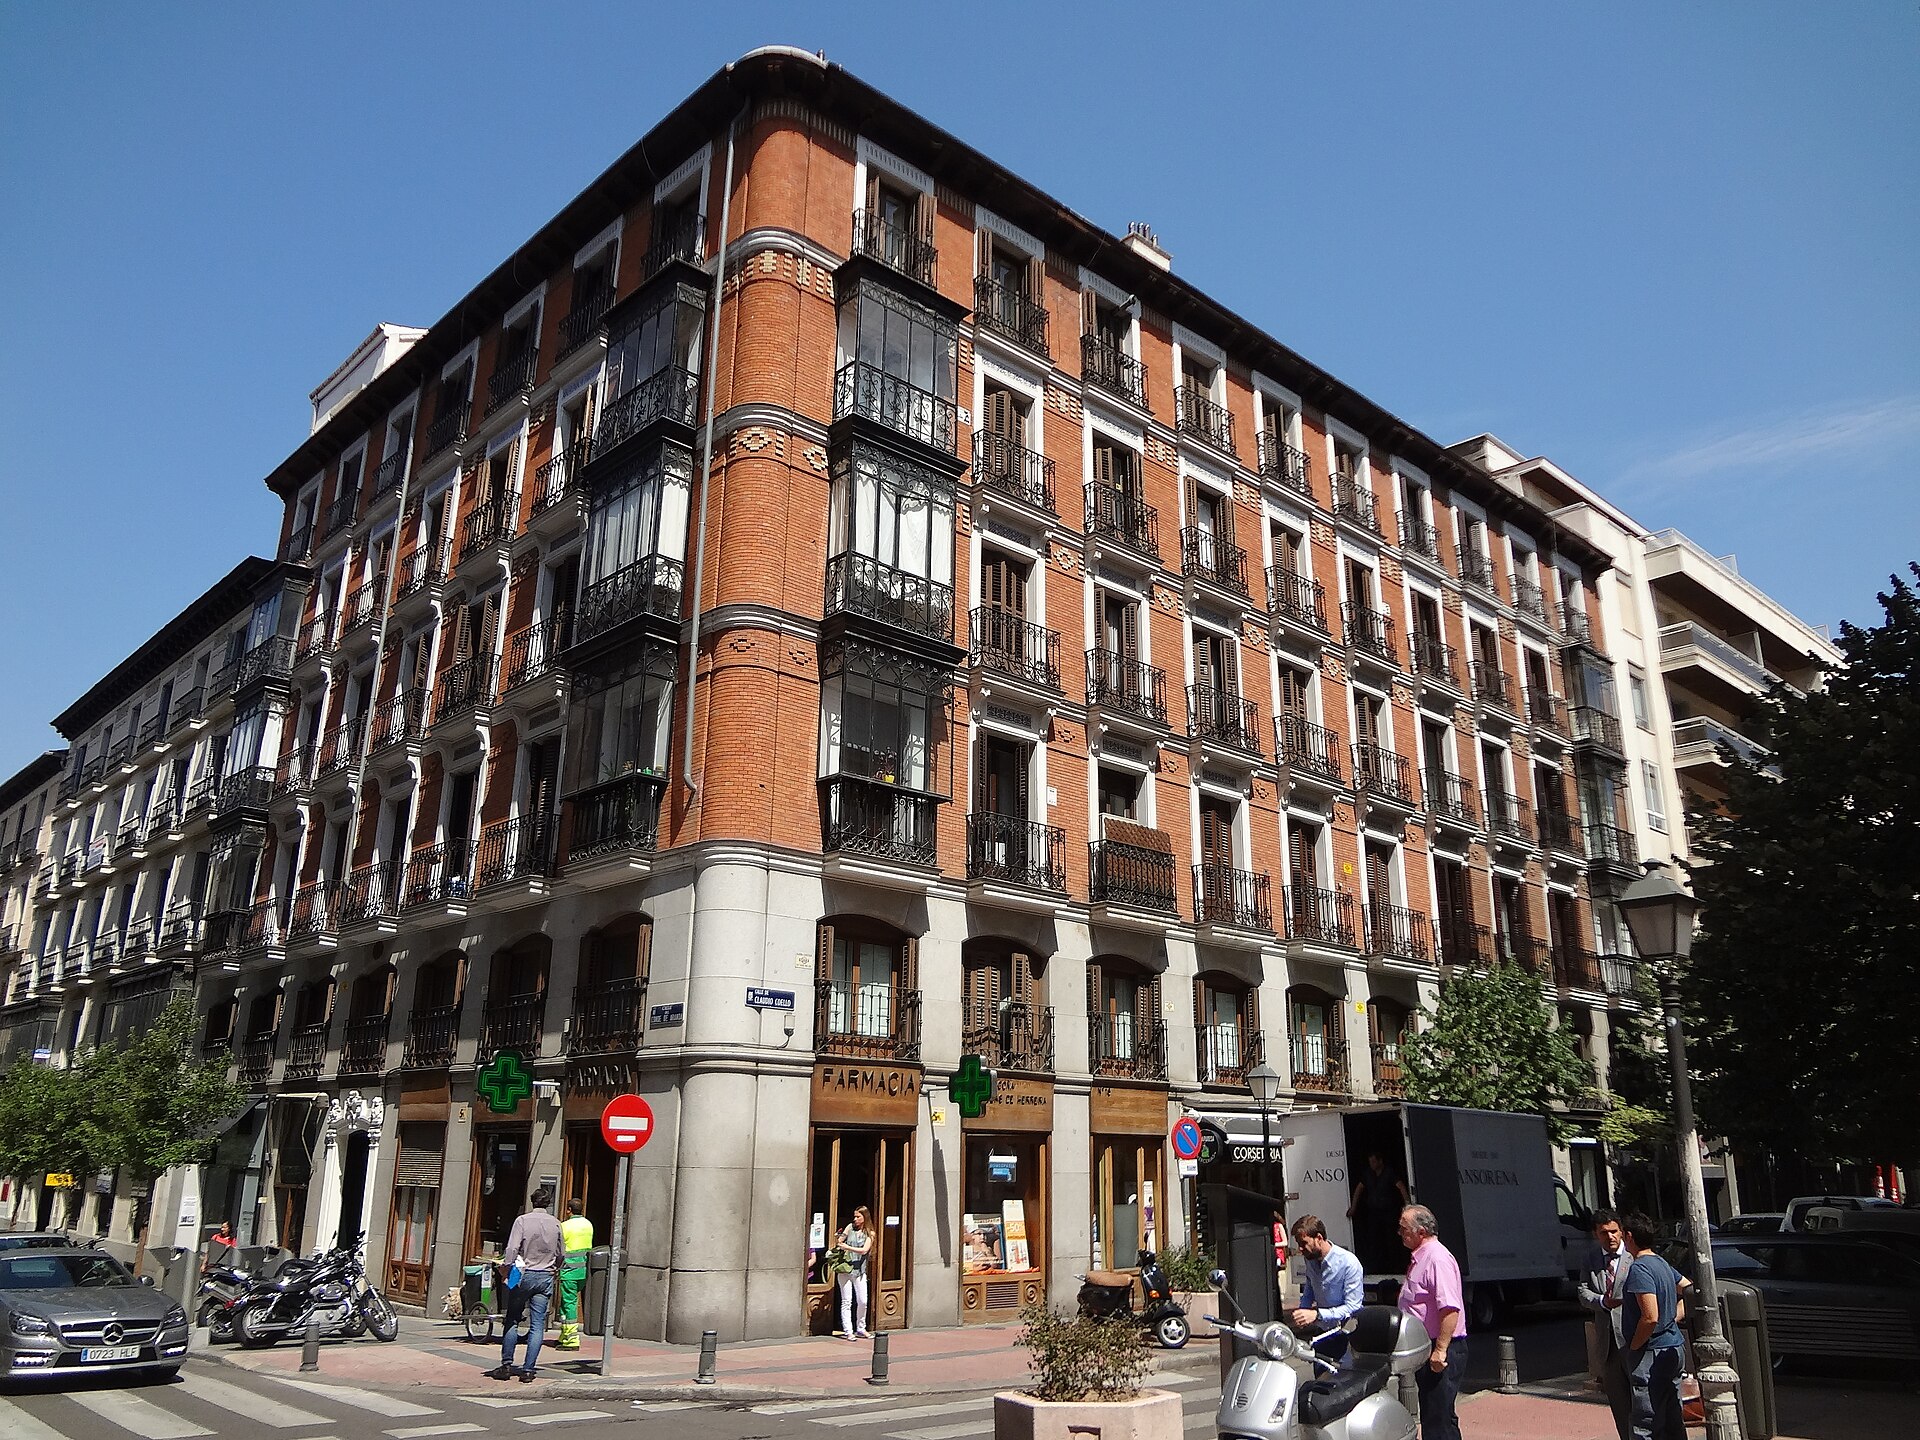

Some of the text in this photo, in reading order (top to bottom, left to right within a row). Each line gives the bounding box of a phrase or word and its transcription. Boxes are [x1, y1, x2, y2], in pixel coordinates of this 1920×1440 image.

[754, 996, 792, 1007] CLAUDIO COELLO
[822, 1067, 915, 1097] FARMACIA
[1233, 1146, 1282, 1160] CORSETRIA
[1303, 1168, 1345, 1183] ANSO
[1459, 1168, 1519, 1186] ANSORENA
[89, 1349, 115, 1360] 0723
